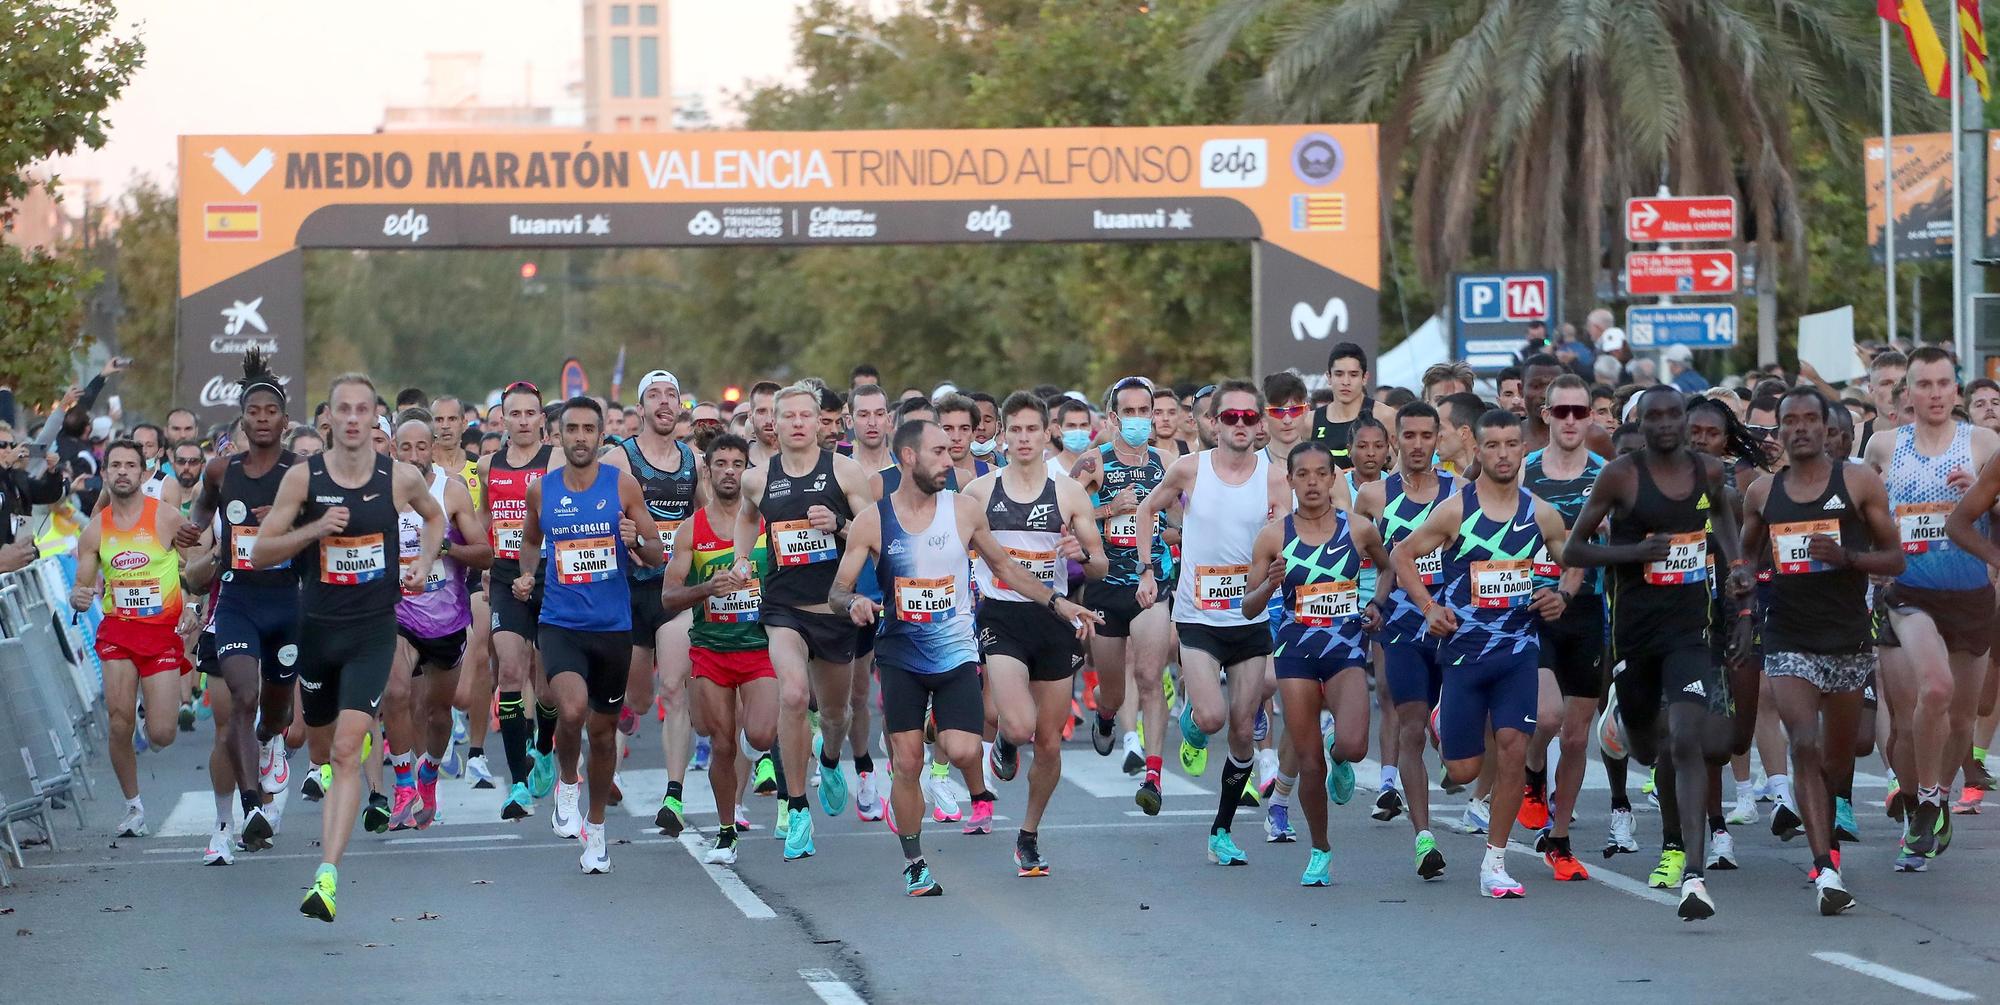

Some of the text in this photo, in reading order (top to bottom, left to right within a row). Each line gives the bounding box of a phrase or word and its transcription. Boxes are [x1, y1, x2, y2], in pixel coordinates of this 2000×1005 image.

[284, 140, 1193, 189] MEDIO MARATÓN VALENCIA TRINIDAD ALFONSO
[1210, 146, 1257, 180] edp
[510, 213, 583, 235] luanvi
[965, 204, 1012, 237] edp
[1093, 208, 1165, 230] luanvi
[383, 208, 429, 242] edp
[1472, 284, 1545, 316] P 1A
[1703, 312, 1732, 341] 14
[1917, 516, 1930, 525] 12
[551, 526, 570, 535] team
[662, 532, 672, 540] 90
[796, 530, 809, 540] 42
[1910, 527, 1945, 540] MOEN
[787, 539, 828, 553] WAGELI
[1676, 546, 1689, 556] 70
[346, 549, 359, 558] 62
[578, 550, 595, 560] 106
[114, 556, 147, 567] Serrano
[335, 557, 376, 571] DOUMA
[573, 560, 607, 572] SAMIR
[1665, 556, 1698, 570] PACER
[1220, 576, 1232, 586] 22
[1499, 572, 1512, 582] 24
[129, 588, 140, 597] 88
[1479, 580, 1532, 595] BEN DAOUD
[726, 592, 738, 601] 27
[921, 589, 934, 598] 46
[1321, 593, 1339, 603] 167
[124, 597, 150, 607] TINET
[710, 602, 720, 611] A.
[908, 597, 952, 611] DE LEÓN
[1310, 602, 1352, 616] MULATE
